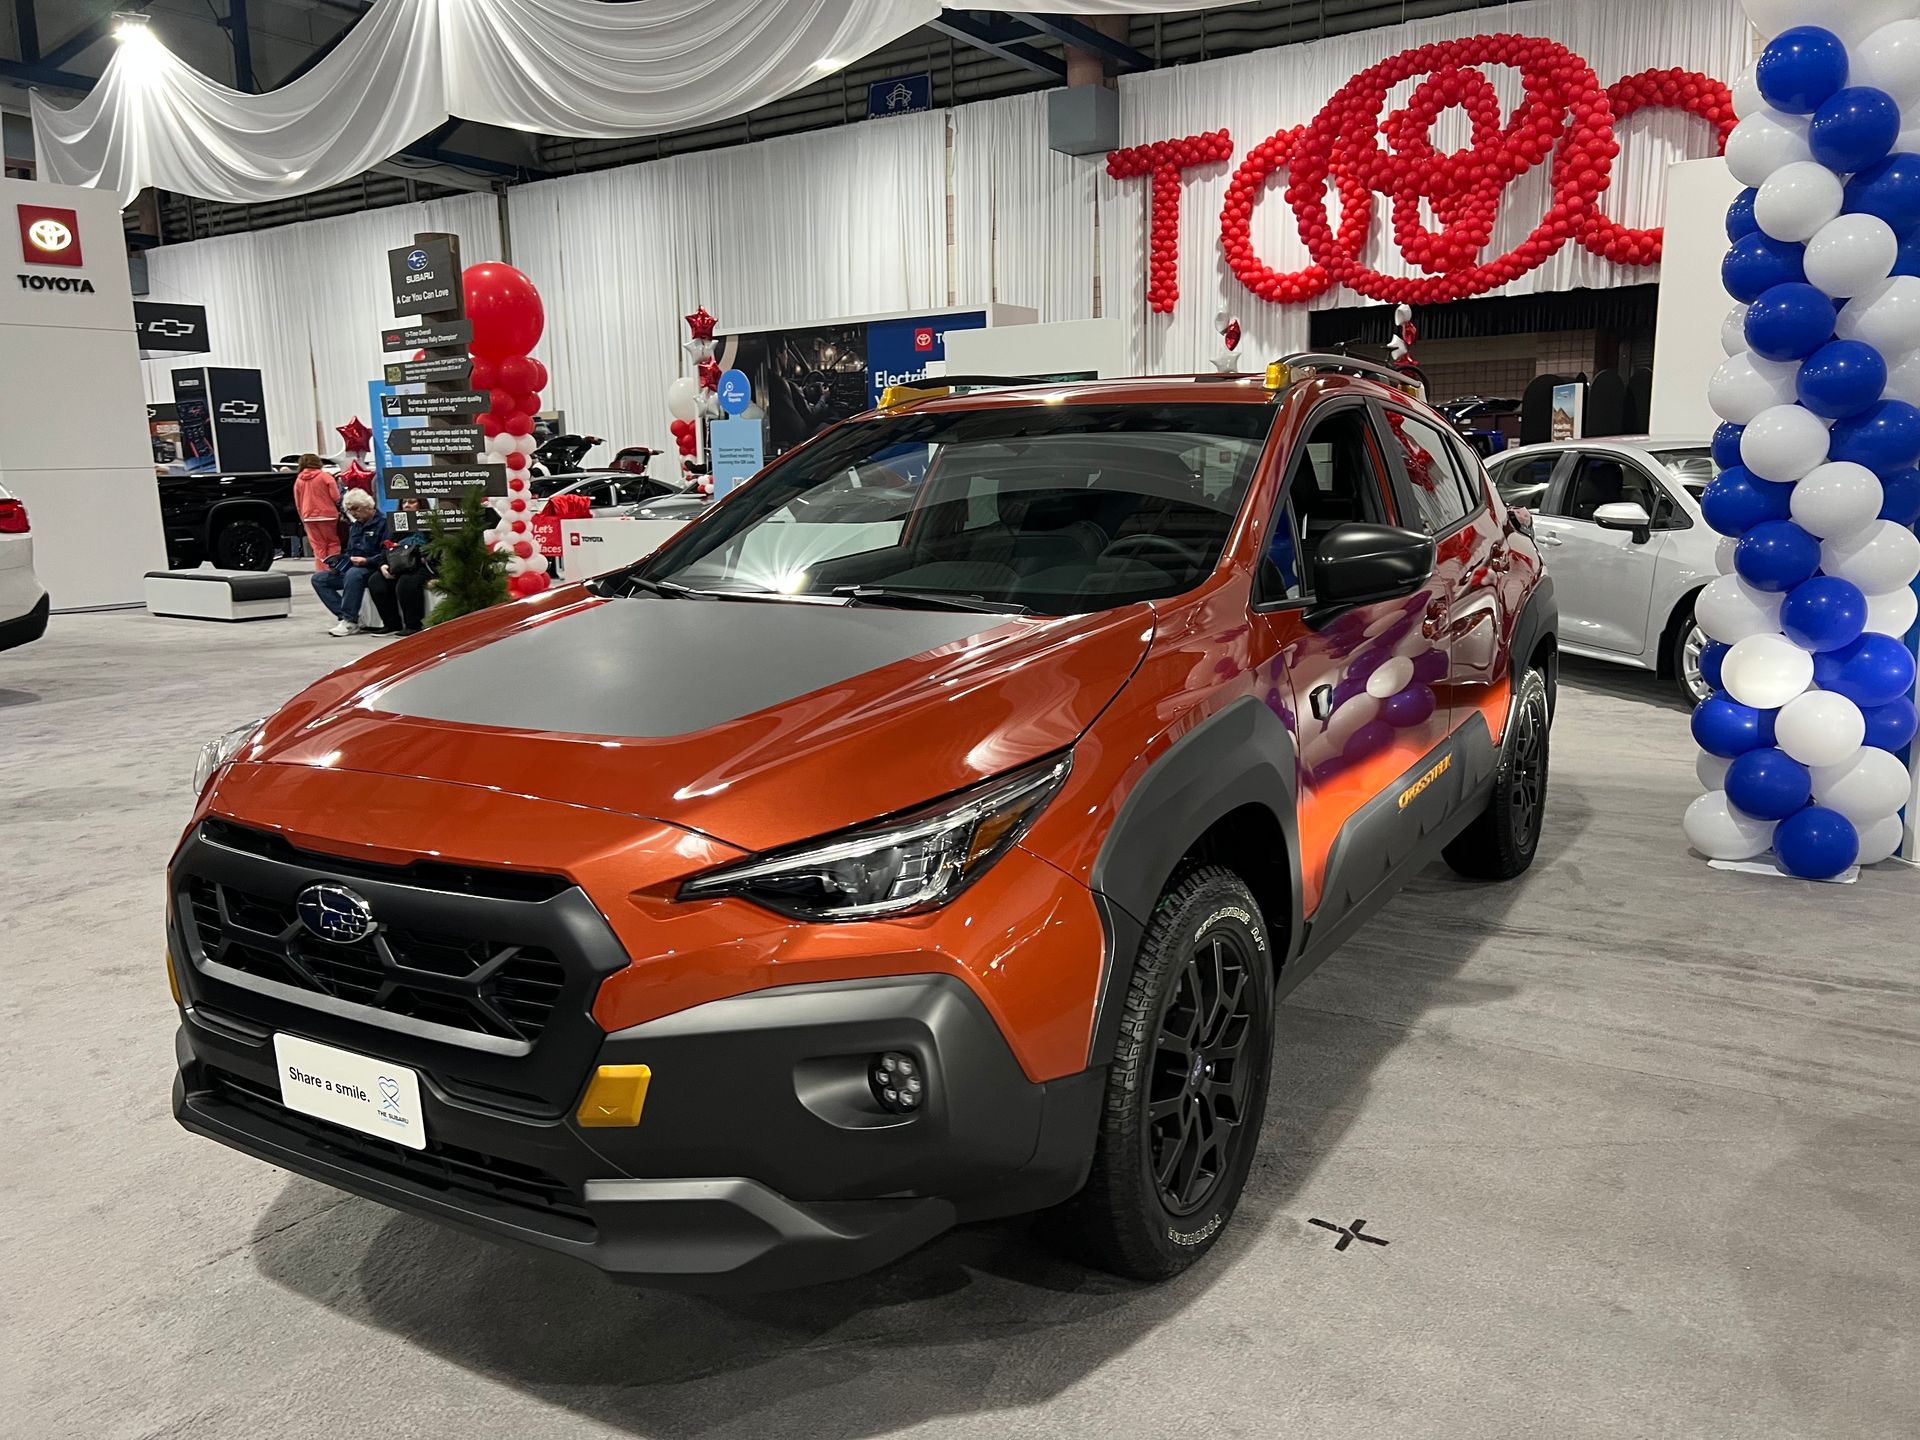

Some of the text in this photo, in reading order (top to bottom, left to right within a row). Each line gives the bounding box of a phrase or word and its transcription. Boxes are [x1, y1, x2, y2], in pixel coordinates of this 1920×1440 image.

[17, 275, 95, 292] TOYOTA
[406, 272, 434, 284] SUBARU
[396, 288, 449, 304] A Car You Can Love
[875, 368, 928, 388] Electrif
[534, 525, 553, 533] Let's
[534, 534, 547, 543] Go
[539, 544, 562, 553] laces
[1399, 752, 1452, 809] CROSSTREK
[289, 1066, 370, 1102] Share a smile.
[388, 1113, 409, 1124] SUBARU
[1168, 1214, 1222, 1246] YOKOHAMA
